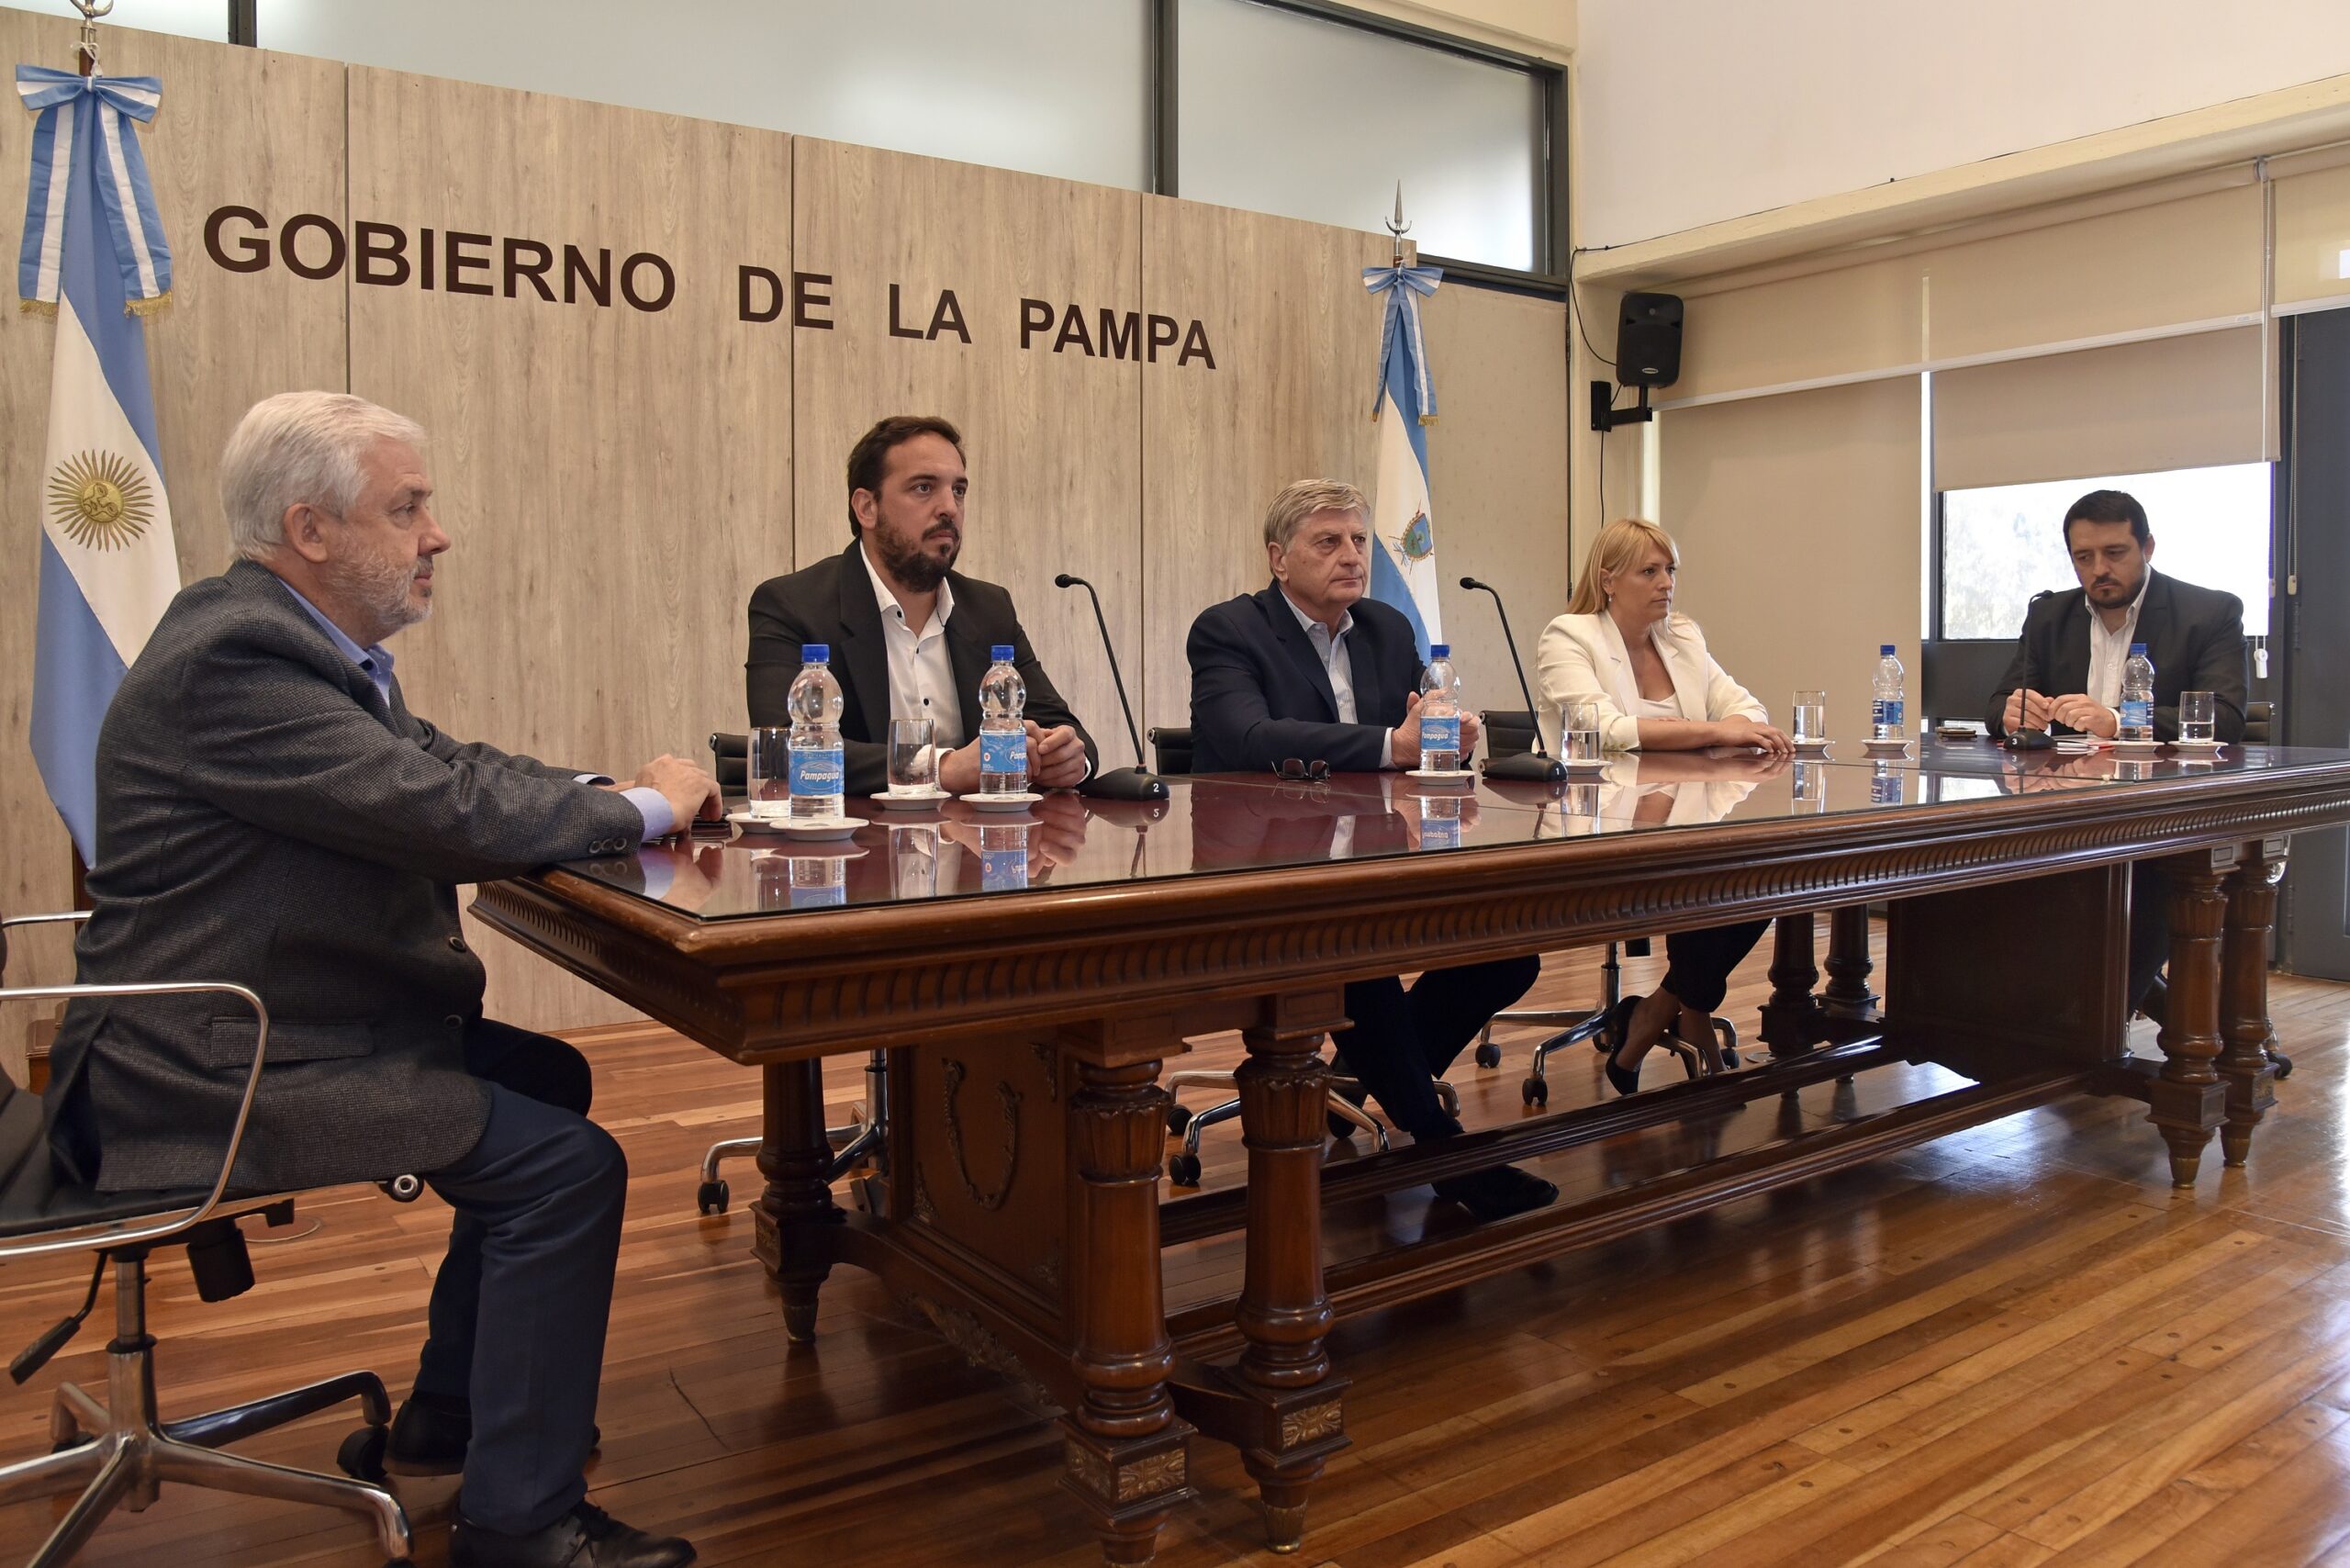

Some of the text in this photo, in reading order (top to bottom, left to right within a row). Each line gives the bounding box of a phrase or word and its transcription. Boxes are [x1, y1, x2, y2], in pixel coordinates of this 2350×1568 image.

[204, 206, 1217, 370] GOBIERNO DE LA PAMPA
[800, 769, 840, 782] Pampagua
[1555, 767, 1560, 776] 1
[1153, 783, 1159, 793] 2
